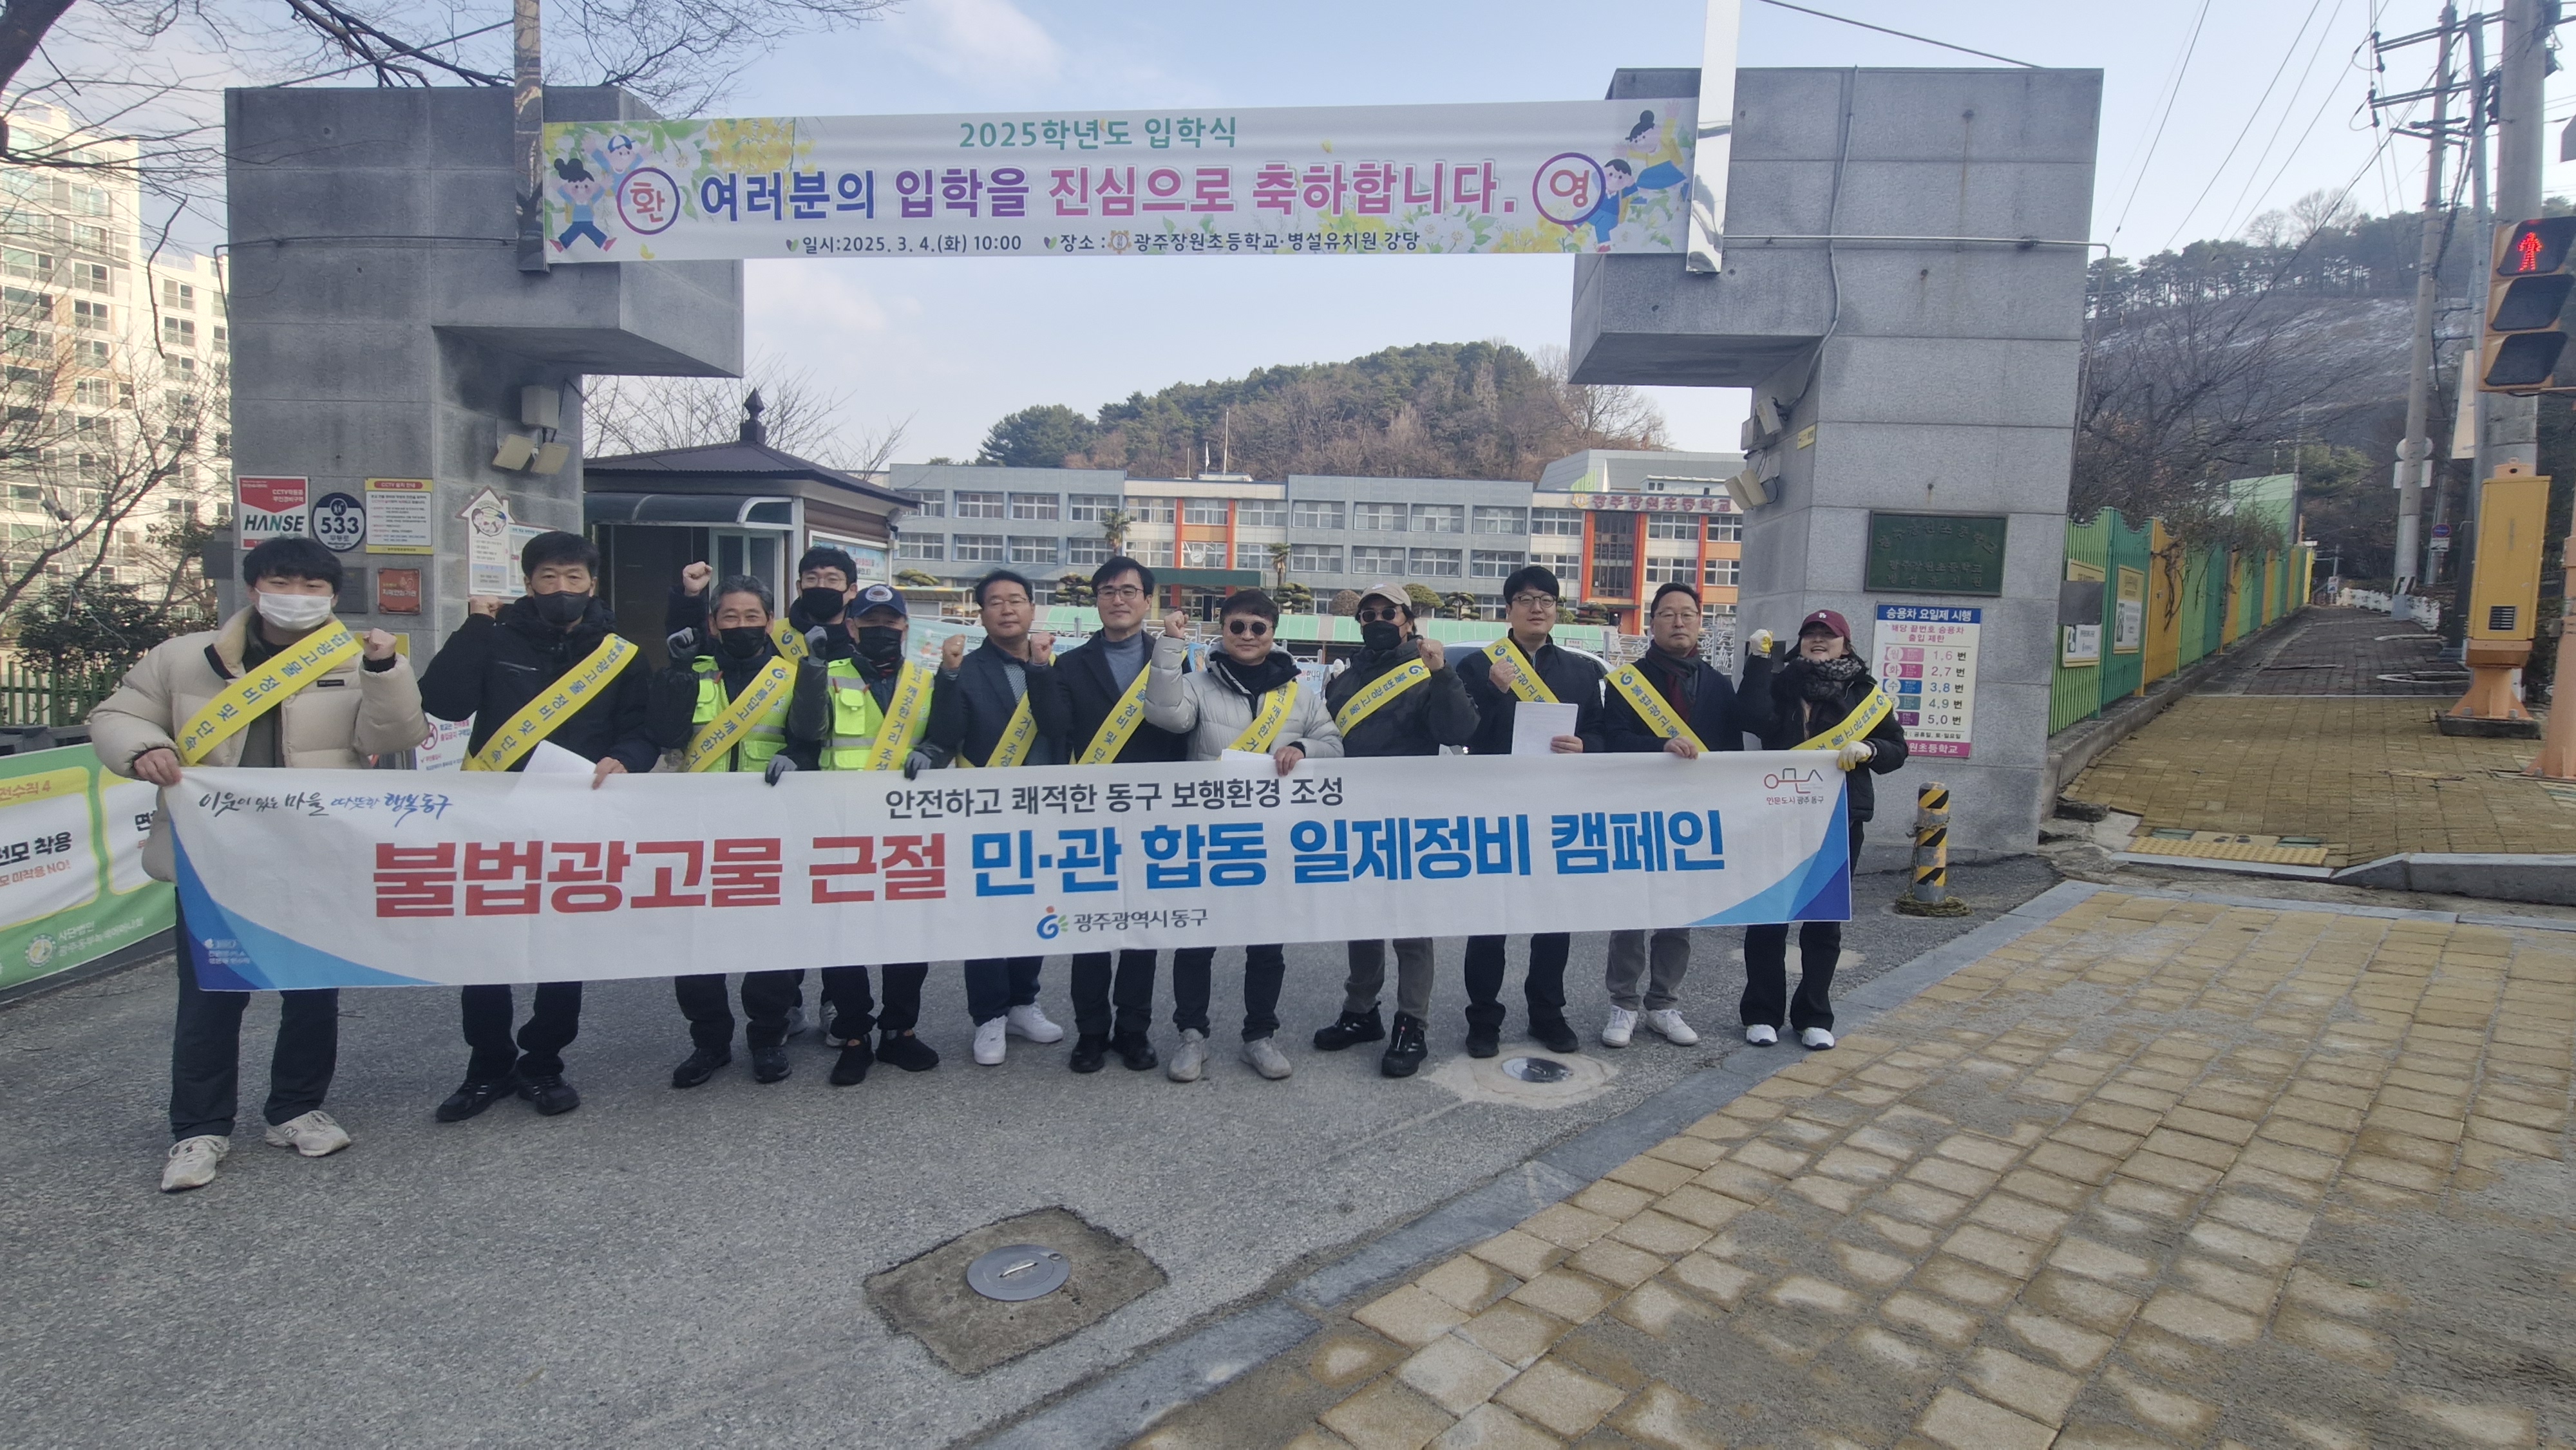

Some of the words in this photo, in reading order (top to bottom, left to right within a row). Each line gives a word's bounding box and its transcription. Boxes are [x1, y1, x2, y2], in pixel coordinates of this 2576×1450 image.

[960, 118, 1132, 149] 2025학년도
[1144, 117, 1236, 149] 입학식
[701, 170, 874, 220] 여러분의
[895, 167, 1030, 218] 입학을
[1048, 166, 1235, 217] 진심으로
[1253, 163, 1515, 214] 축하합니다.
[1549, 169, 1588, 208] 영
[630, 183, 665, 223] 환
[974, 235, 1021, 250] 10:00
[1060, 234, 1095, 252] 장소
[1385, 232, 1420, 250] 강당
[1593, 494, 1732, 513] 광주장원초등학교
[244, 514, 305, 532] HANSE
[321, 517, 359, 534] 533
[1886, 607, 1917, 620] 승용차
[1918, 608, 1949, 621] 요일제
[1951, 610, 1973, 622] 시행
[1891, 624, 1908, 633] 해당
[1910, 625, 1936, 634] 끝번호
[1938, 626, 1965, 635] 승용차
[1908, 634, 1926, 643] 출입
[1928, 635, 1945, 643] 제한
[569, 642, 625, 695] 불법광고물
[1933, 650, 1953, 661] 1,6
[1957, 652, 1967, 662] 번
[1888, 664, 1899, 676] 화
[1931, 666, 1952, 677] 2,7
[1956, 667, 1965, 677] 번
[242, 675, 281, 705] 정비
[1349, 672, 1408, 715] 불법광고물
[1888, 681, 1899, 692] 수
[1929, 682, 1951, 693] 3,8
[1955, 684, 1964, 694] 번
[216, 702, 240, 722] 및
[538, 693, 569, 722] 정비
[736, 679, 777, 722] 아름답고
[898, 684, 920, 720] 깨끗한
[1928, 698, 1949, 709] 4,9
[1953, 700, 1963, 710] 번
[518, 719, 536, 737] 및
[1014, 715, 1032, 742] 거리
[1115, 703, 1139, 730] 정비
[1258, 704, 1282, 739] 깨끗한
[1830, 702, 1879, 747] 불법광고물
[1927, 714, 1949, 726] 5,0
[1952, 716, 1962, 726] 번
[184, 720, 216, 751] 단속
[700, 719, 739, 754] 깨끗한
[887, 720, 905, 746] 거리
[1103, 730, 1119, 746] 및
[491, 735, 517, 763] 단속
[999, 742, 1019, 767] 조성
[1908, 742, 1959, 754] 원초등학교
[41, 780, 52, 792] 4
[886, 788, 1003, 820] 안전하고
[1012, 783, 1097, 815] 쾌적한
[1106, 782, 1163, 813] 동구
[1171, 777, 1281, 810] 보행환경
[1290, 777, 1344, 806] 조성
[198, 791, 251, 818] 이웃이
[283, 791, 330, 817] 마을
[330, 795, 380, 810] 따뜻한
[1766, 796, 1795, 805] 인문도시
[34, 831, 72, 855] 착용
[12, 865, 46, 883] 미착용
[46, 859, 71, 873] NO!
[373, 838, 783, 918] 불법광고물
[809, 833, 947, 904] 근절
[972, 827, 1122, 897] 민·관
[1141, 822, 1267, 890] 합동
[1290, 814, 1531, 884] 일제정비
[1551, 809, 1725, 875] 캠페인
